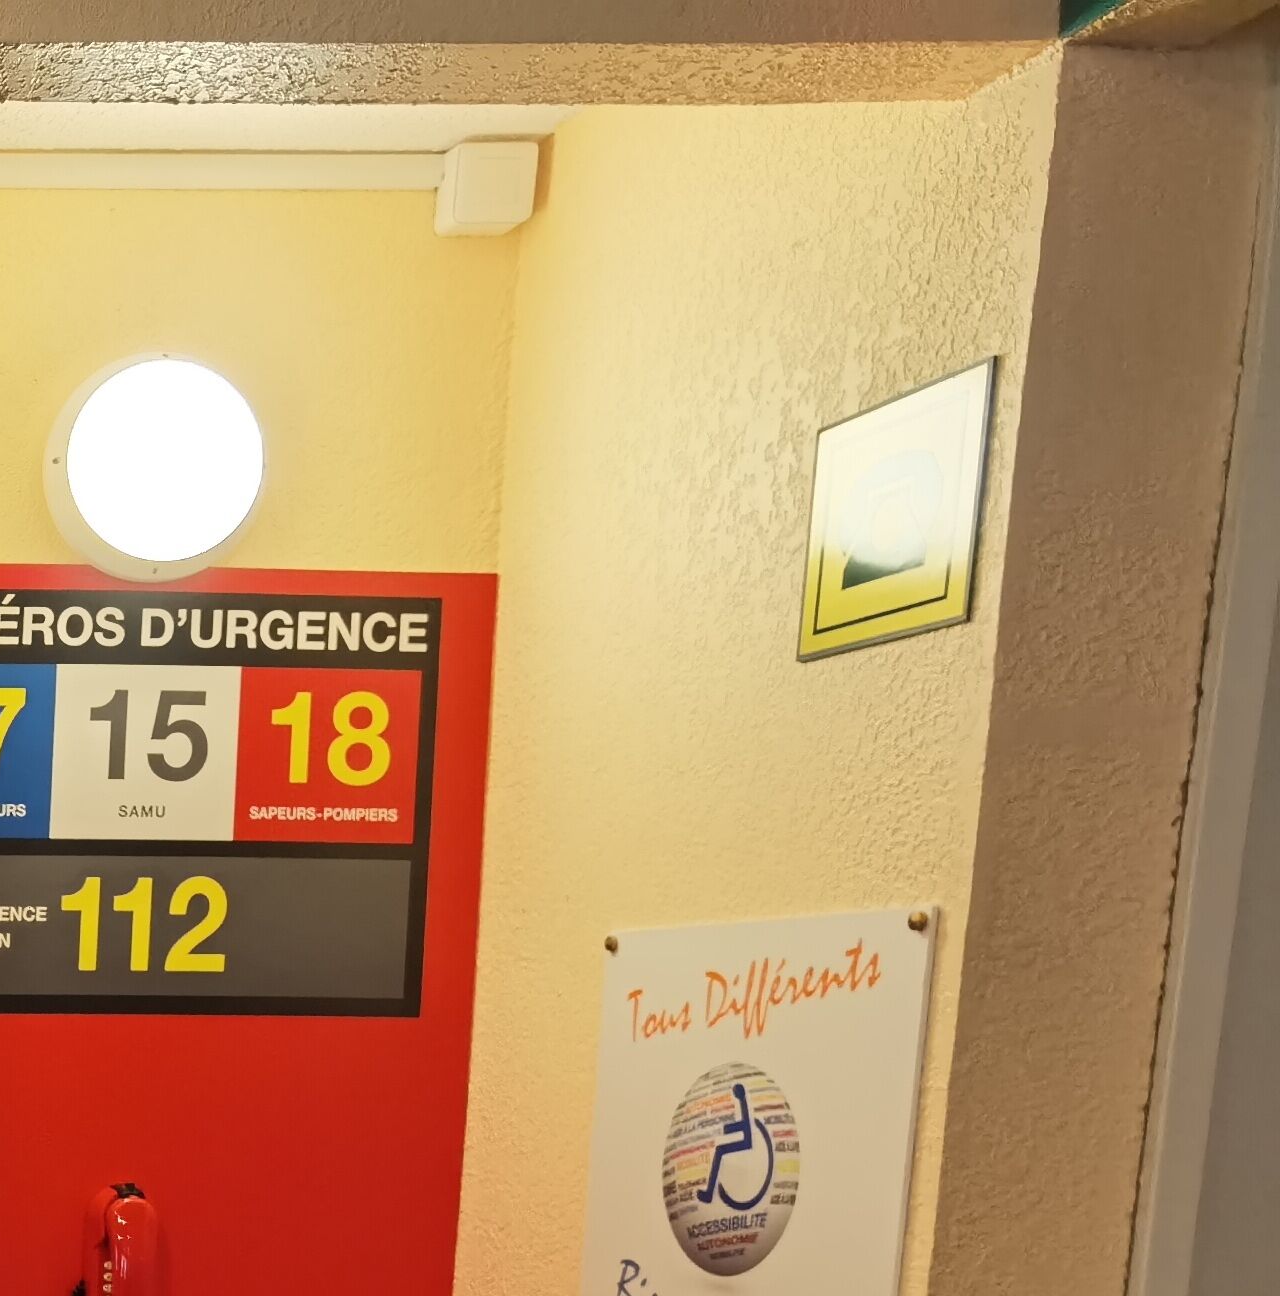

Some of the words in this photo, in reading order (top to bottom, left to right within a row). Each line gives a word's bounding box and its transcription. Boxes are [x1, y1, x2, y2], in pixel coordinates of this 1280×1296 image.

[142, 607, 430, 653] D'URGENCE
[89, 689, 209, 783] 15
[271, 690, 392, 787] 18
[117, 805, 167, 820] SAMU
[248, 805, 399, 823] SAPEURS-POMPIERS
[60, 875, 229, 973] 112
[627, 988, 693, 1043] Tous
[704, 937, 883, 1040] Différents
